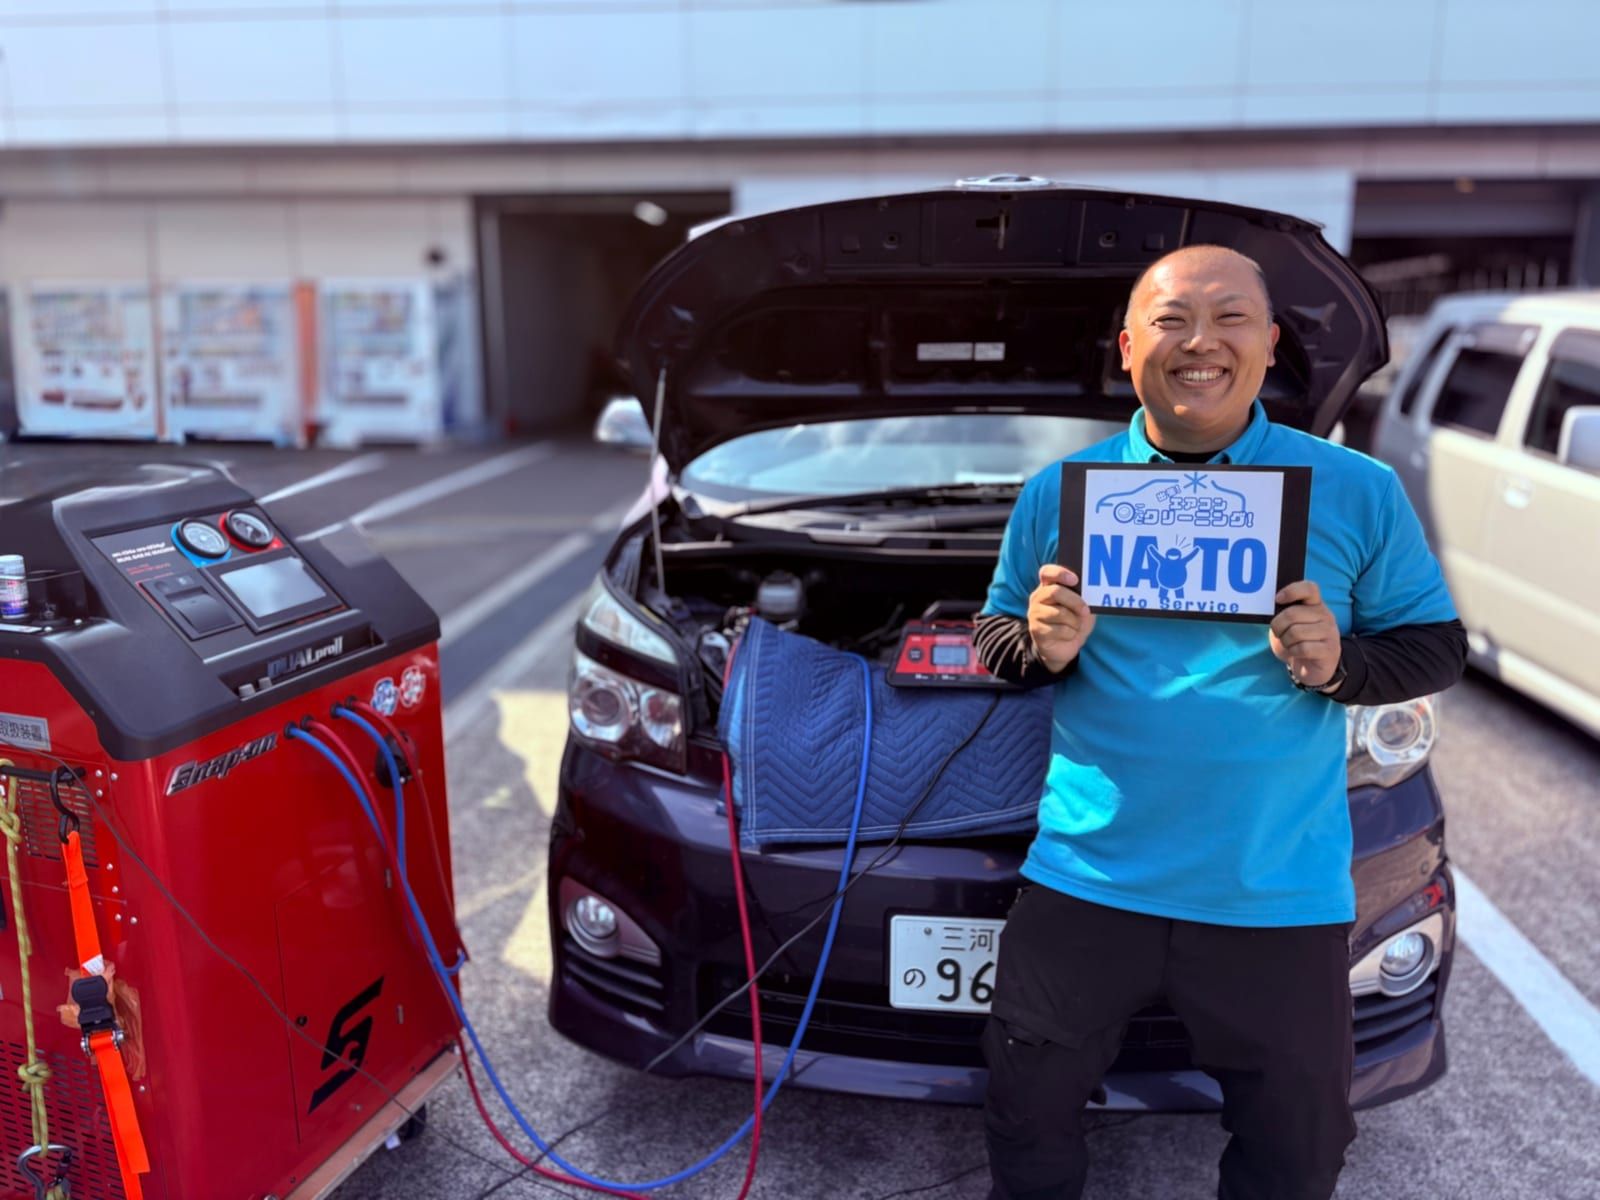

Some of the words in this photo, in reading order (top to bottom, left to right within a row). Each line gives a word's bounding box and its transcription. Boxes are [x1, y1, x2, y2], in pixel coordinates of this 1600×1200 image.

[1169, 497, 1228, 511] エアコン
[1142, 509, 1254, 528] クリーニング!
[1101, 593, 1148, 608] Auto
[1159, 597, 1240, 613] Service
[941, 926, 995, 952] 三河
[903, 968, 926, 989] の
[936, 957, 995, 1004] 96
